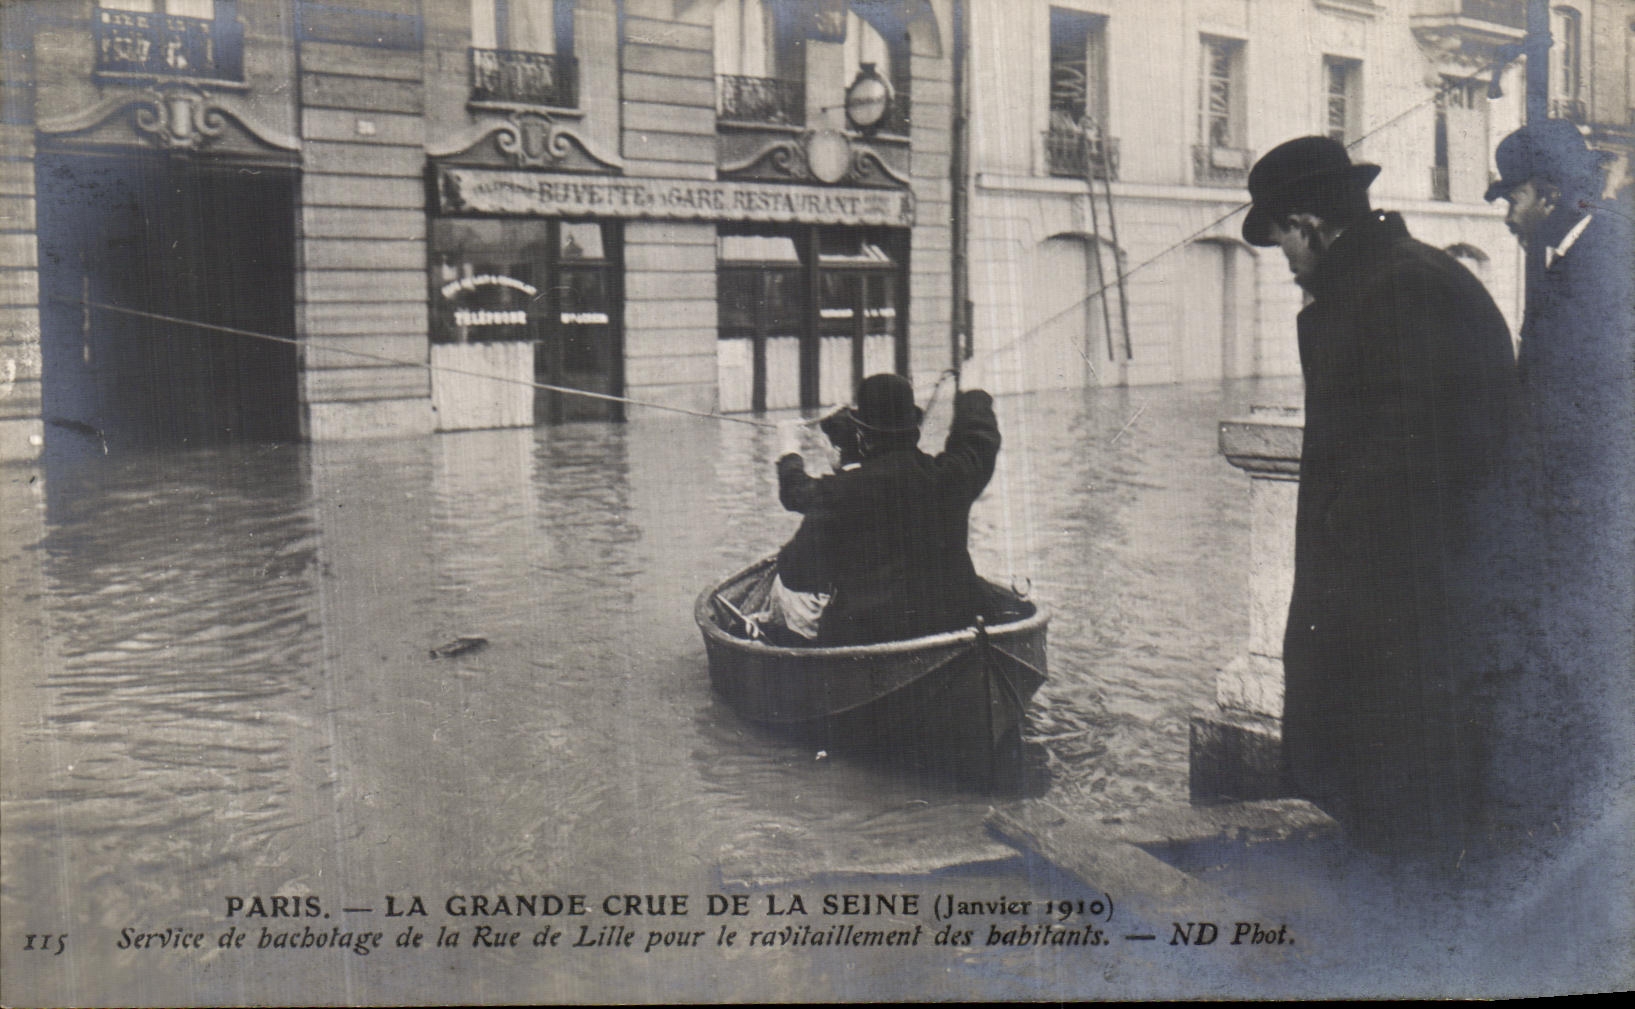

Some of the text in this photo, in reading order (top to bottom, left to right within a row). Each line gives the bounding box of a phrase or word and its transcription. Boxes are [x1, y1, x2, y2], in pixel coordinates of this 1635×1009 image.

[538, 182, 645, 207] BUVETTE
[669, 187, 724, 211] GARE
[734, 190, 860, 216] RESTAURANT
